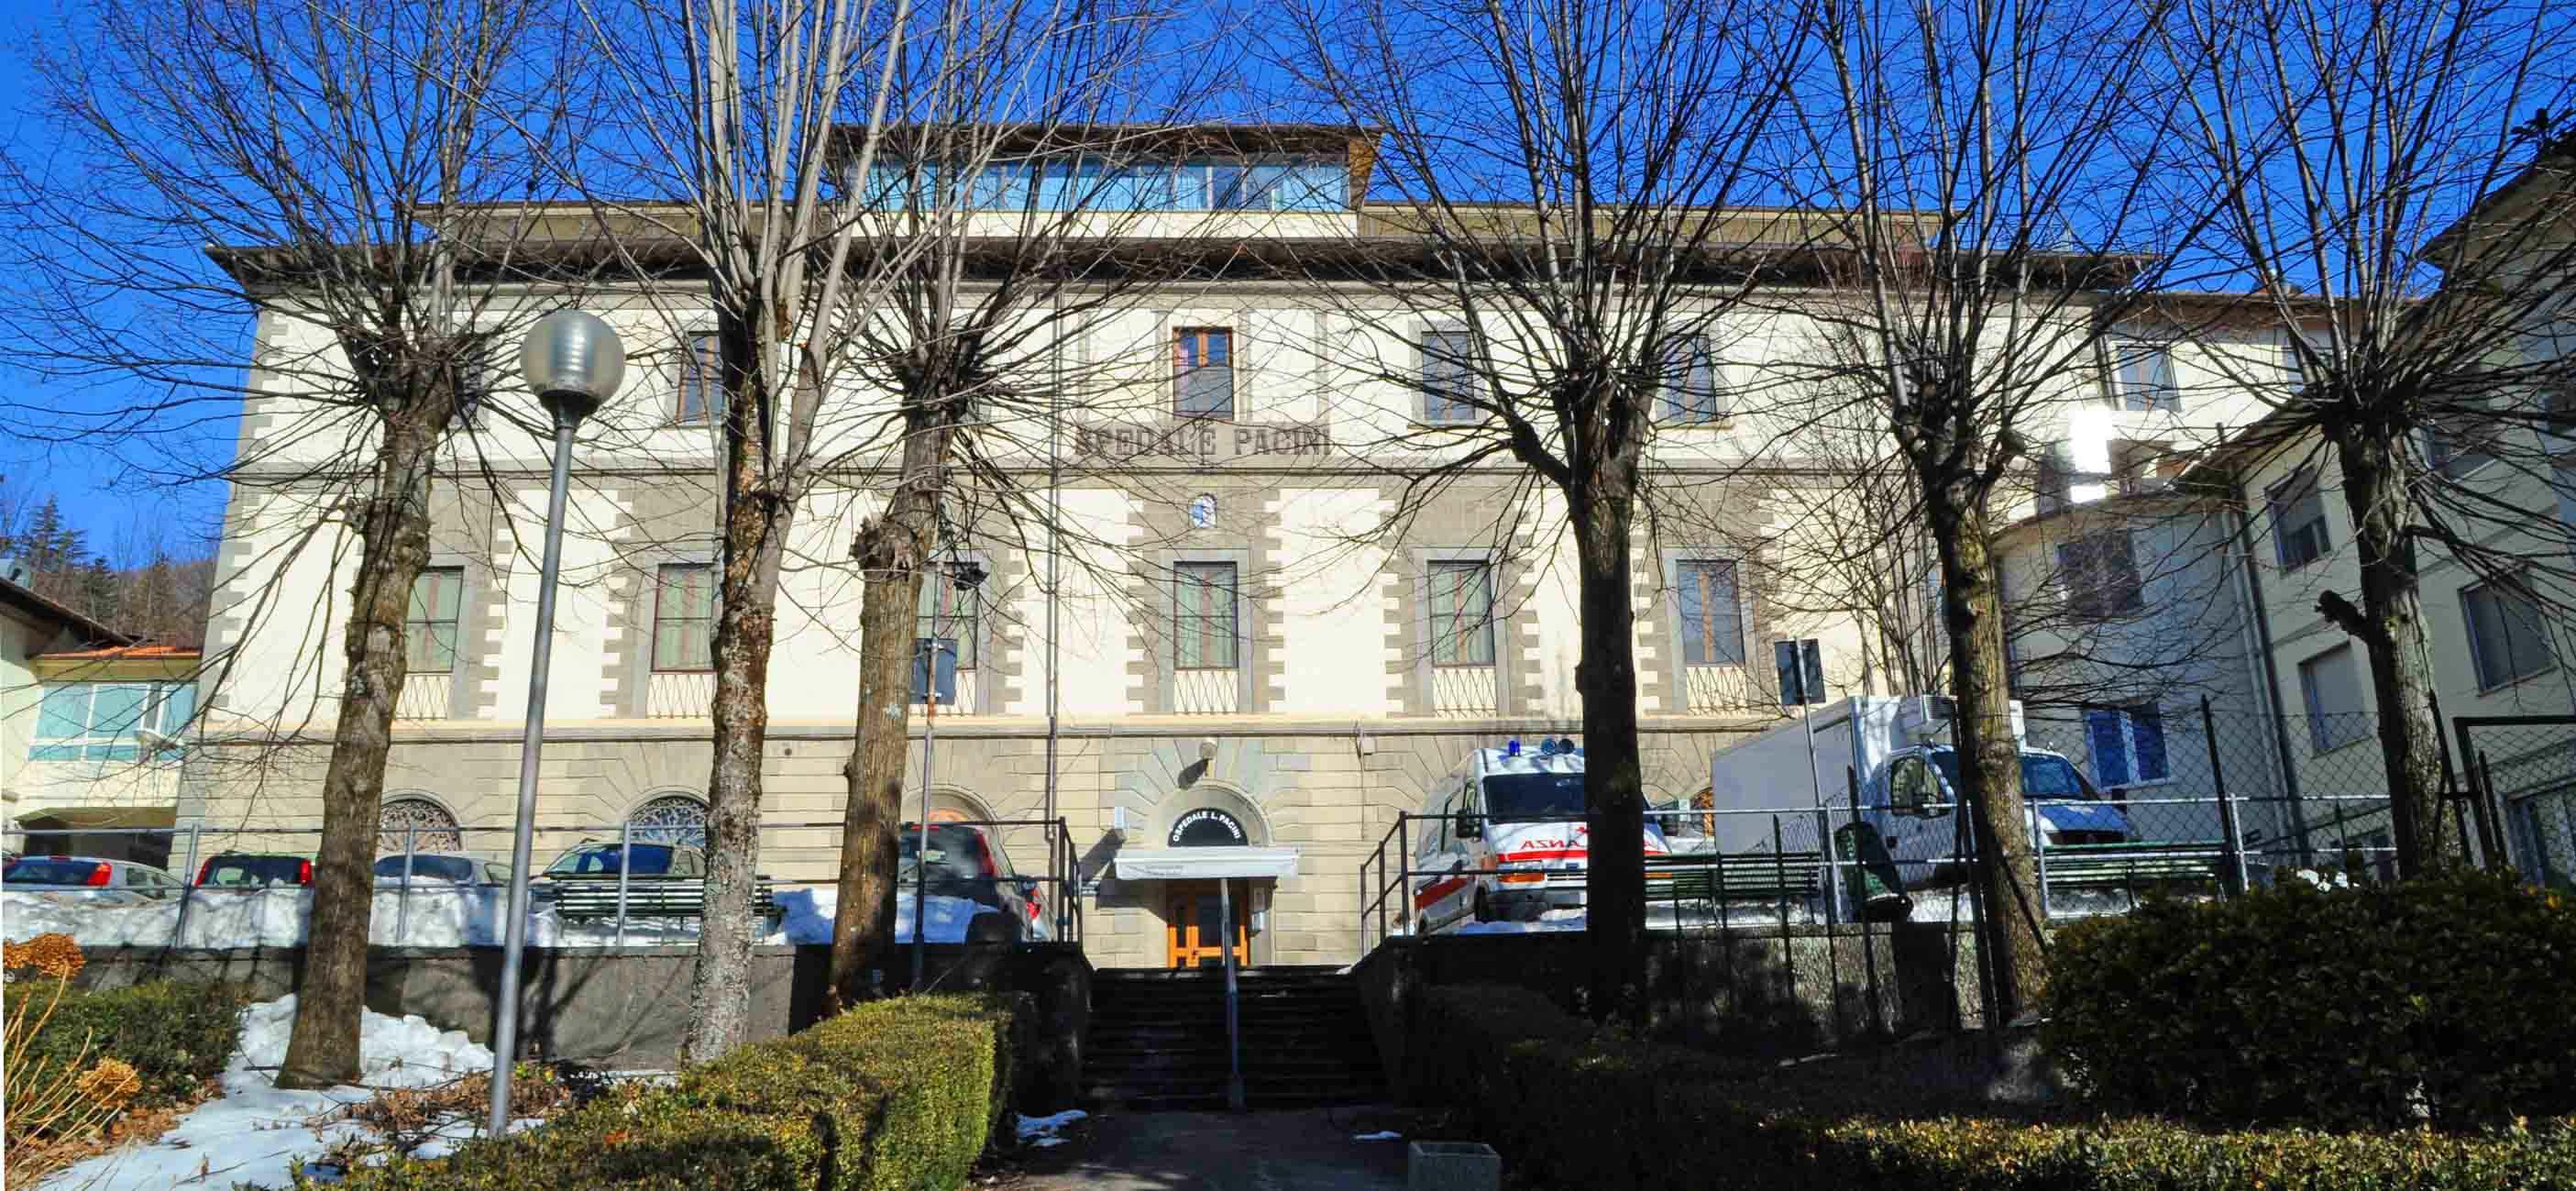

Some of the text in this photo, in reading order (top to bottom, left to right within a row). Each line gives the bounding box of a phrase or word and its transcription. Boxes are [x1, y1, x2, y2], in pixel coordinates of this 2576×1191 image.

[1234, 427, 1330, 456] PACINI
[1172, 811, 1208, 843] OSPEDALE
[1218, 813, 1242, 839] PACINI
